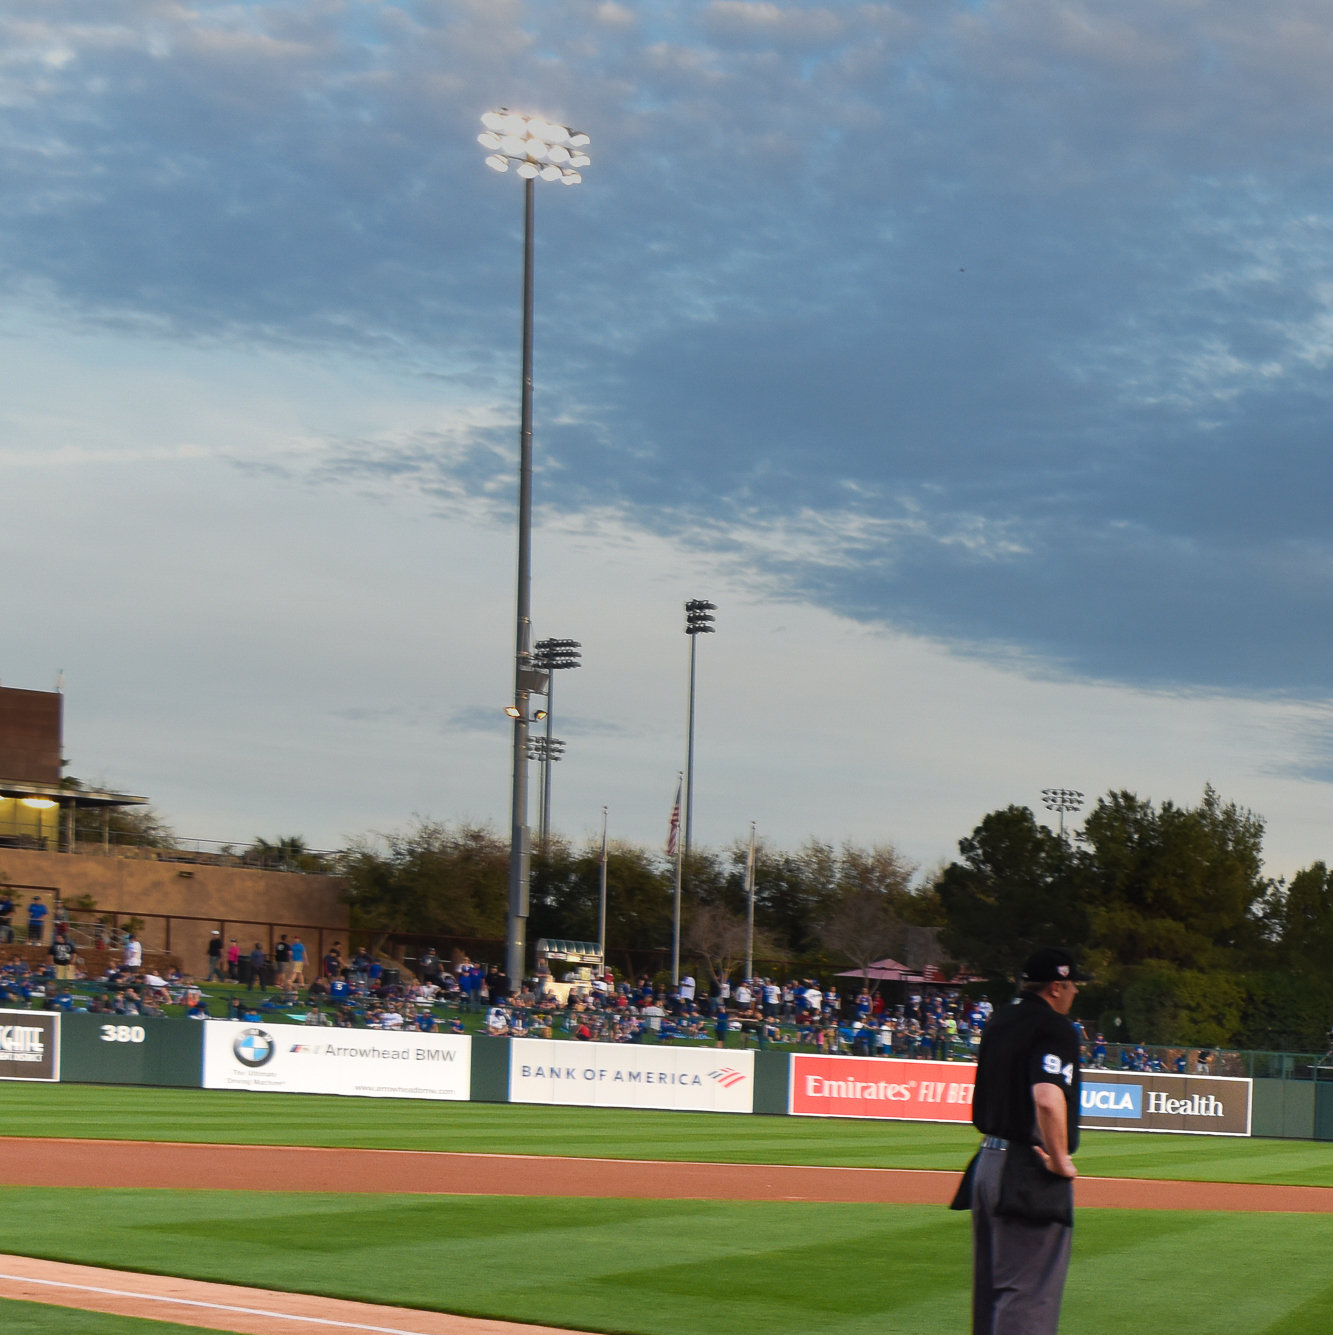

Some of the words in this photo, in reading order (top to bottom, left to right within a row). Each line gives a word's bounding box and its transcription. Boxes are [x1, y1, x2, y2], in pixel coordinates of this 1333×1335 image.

[0, 1025, 45, 1052] GATE
[100, 1024, 145, 1043] 380
[324, 1043, 410, 1061] Arrowhead
[414, 1047, 457, 1063] BMW
[520, 1064, 577, 1081] BANK
[583, 1068, 607, 1082] OF
[613, 1070, 703, 1087] AMERICA
[1042, 1052, 1074, 1086] 94
[804, 1074, 912, 1102] Emirates
[917, 1081, 945, 1103] FLY
[1080, 1089, 1135, 1111] UCLA
[1146, 1091, 1225, 1117] Health
